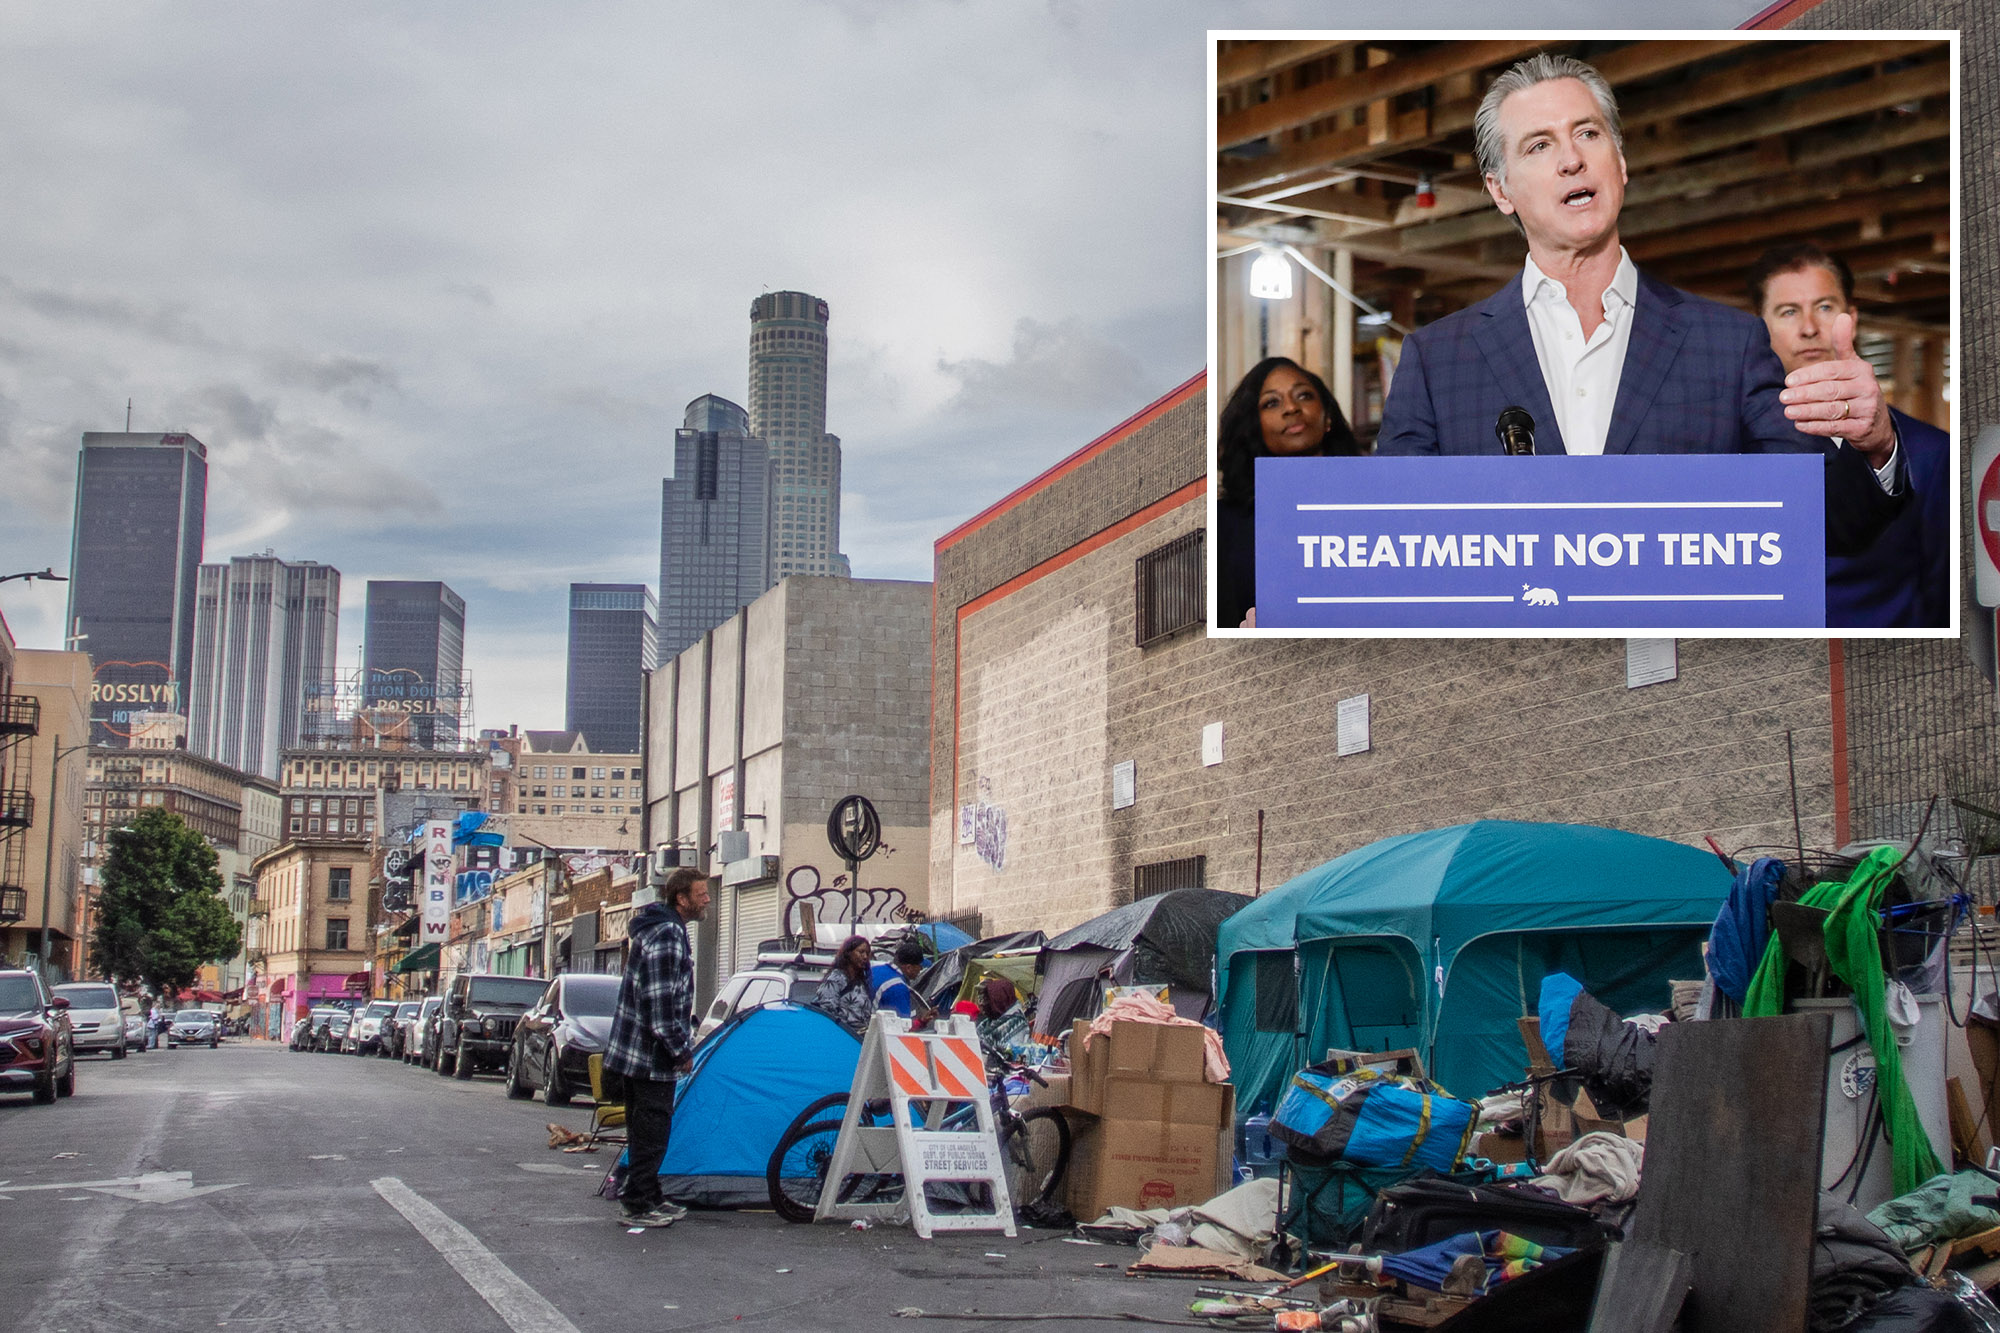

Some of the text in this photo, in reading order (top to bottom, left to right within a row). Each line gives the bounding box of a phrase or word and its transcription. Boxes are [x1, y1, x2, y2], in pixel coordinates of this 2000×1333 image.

[1297, 532, 1783, 568] TREATMENT NOT TENTS
[91, 683, 175, 702] ROSSLYN
[346, 684, 404, 697] MILLION
[112, 710, 145, 724] HOTEL
[426, 827, 447, 934] RANBOW
[924, 1160, 988, 1171] STREET SERVICES
